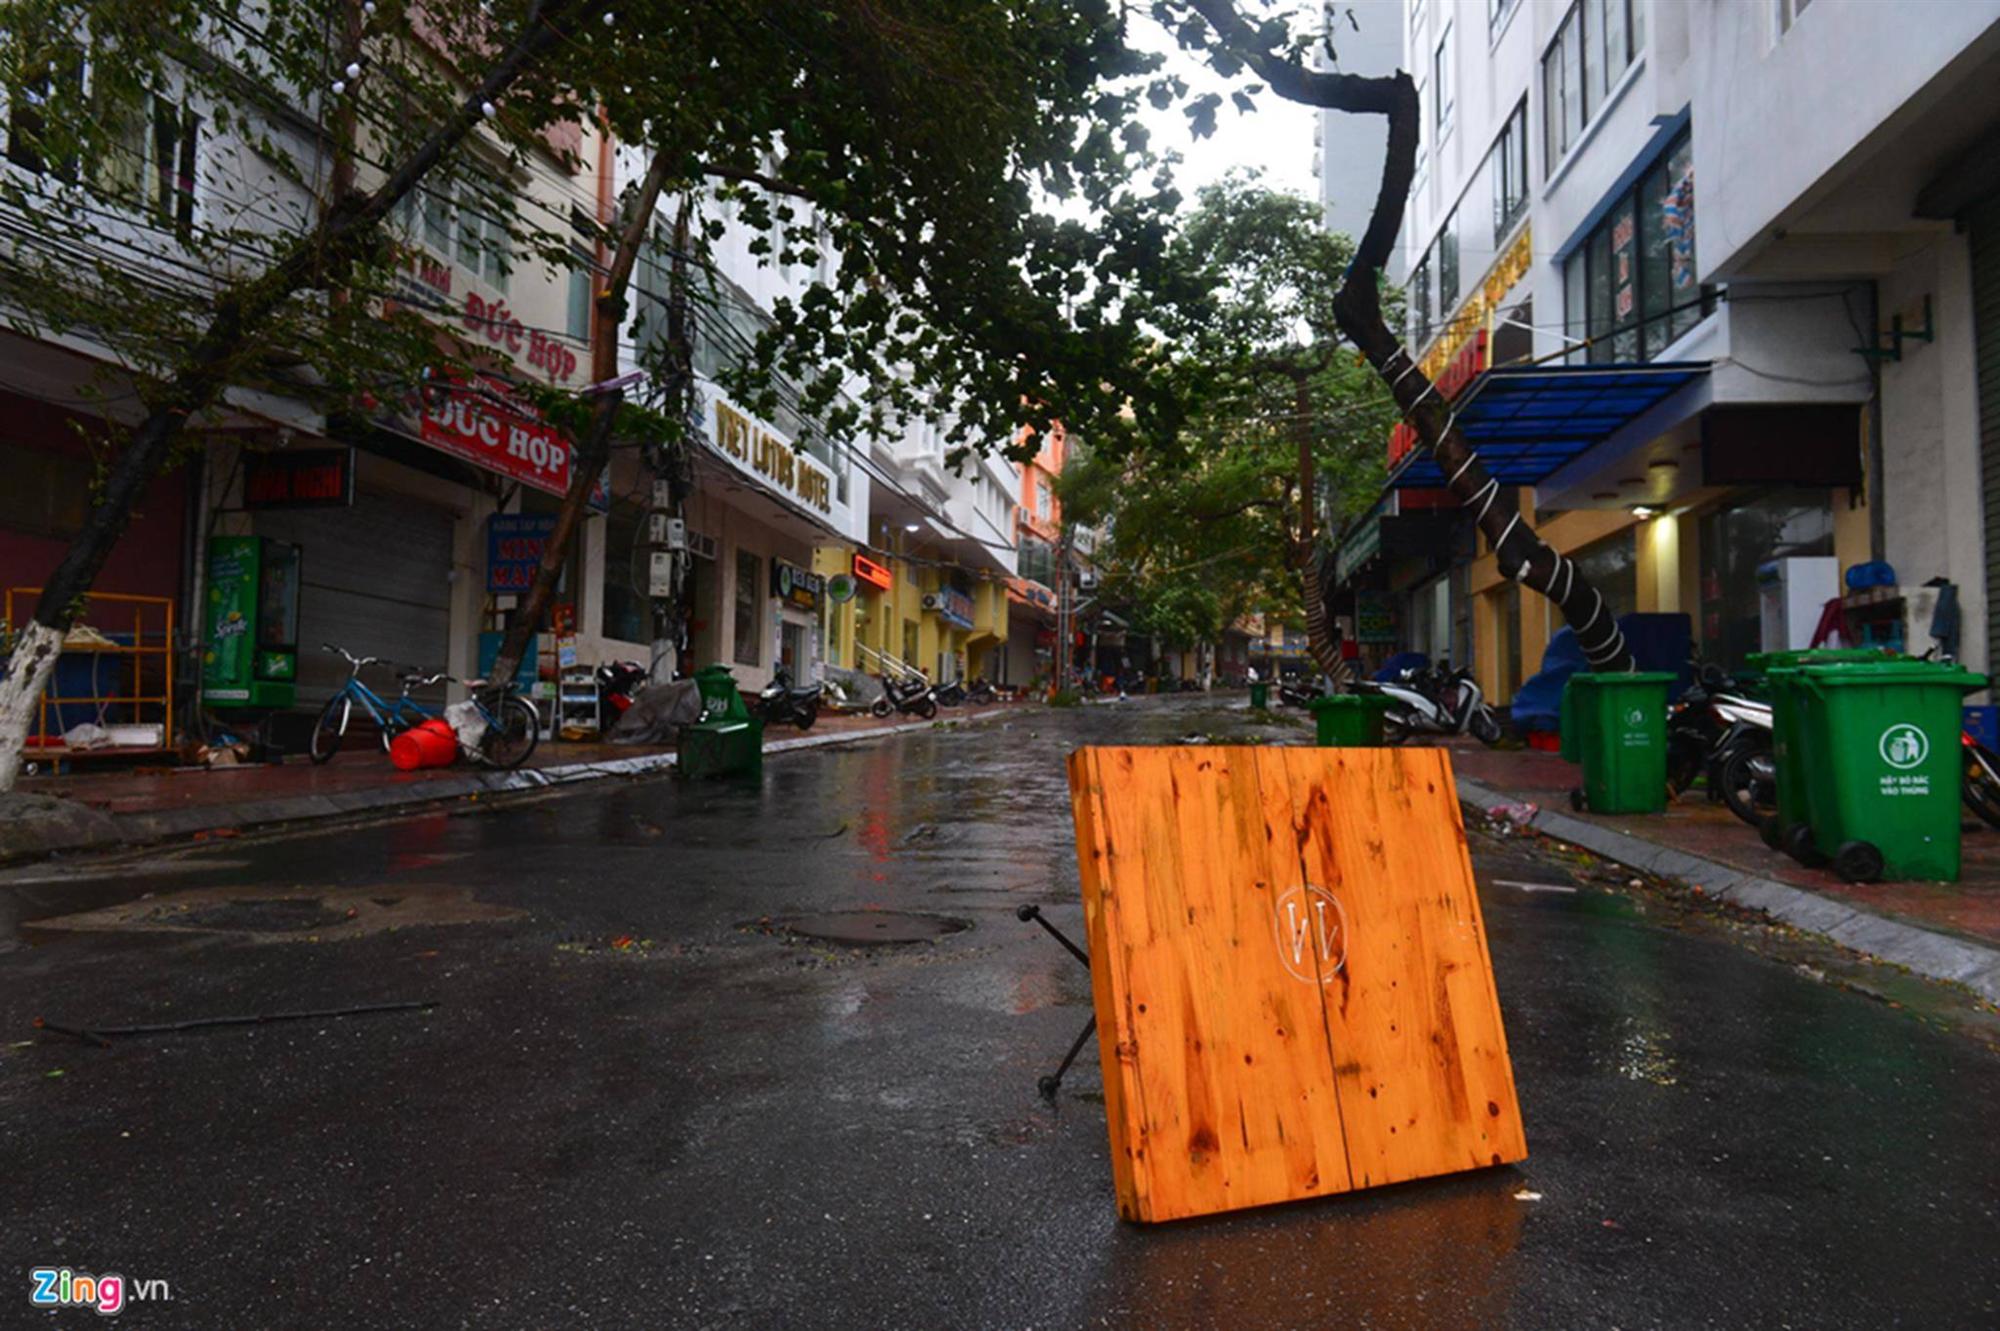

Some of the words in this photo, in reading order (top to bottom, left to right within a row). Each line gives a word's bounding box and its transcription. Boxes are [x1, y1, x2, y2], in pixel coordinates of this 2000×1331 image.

[463, 291, 525, 354] ĐỨC
[526, 330, 577, 383] HỢP
[506, 425, 566, 475] HỢP
[752, 426, 795, 491] LOTUS
[796, 458, 831, 514] HOTEL
